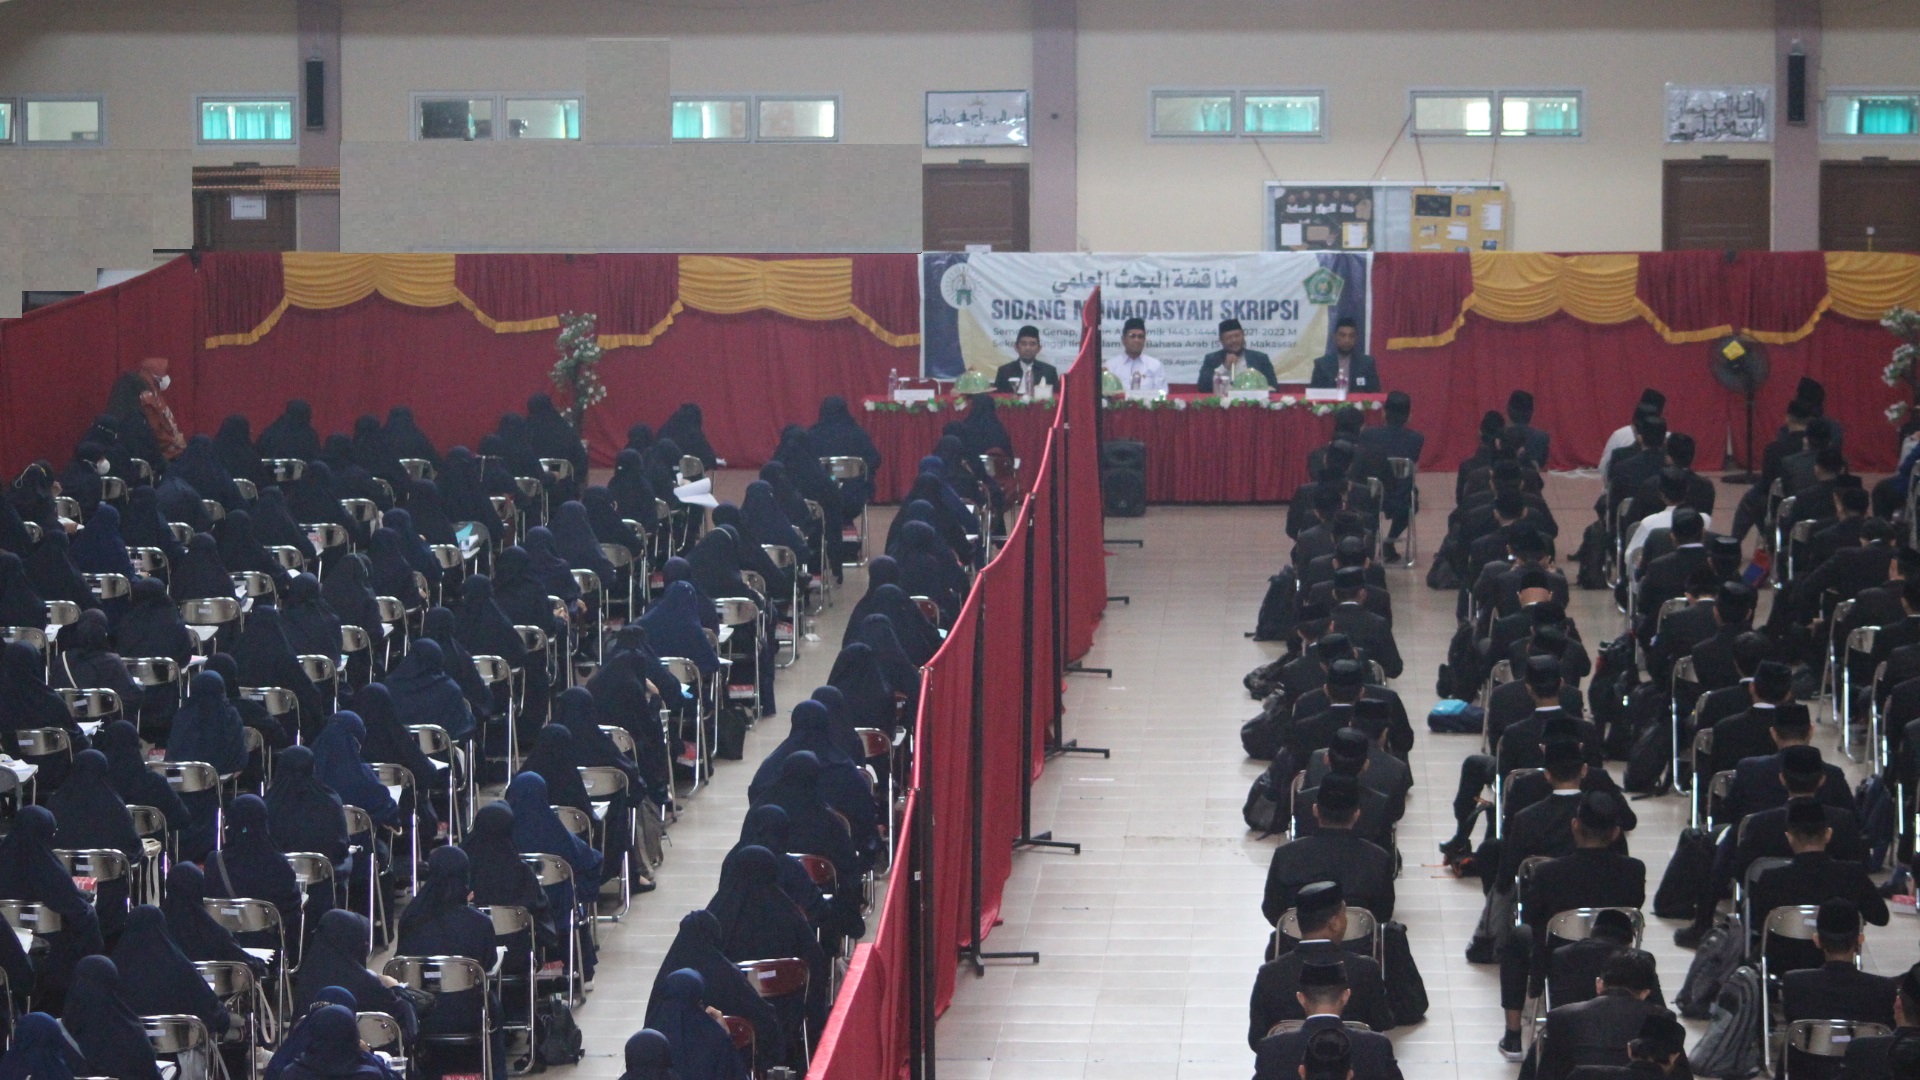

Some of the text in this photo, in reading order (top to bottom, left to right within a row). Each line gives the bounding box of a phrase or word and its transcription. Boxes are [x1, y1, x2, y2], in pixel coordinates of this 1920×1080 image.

[1114, 269, 1169, 295] البحث
[1172, 266, 1238, 288] مناقشة
[991, 299, 1066, 320] SIDANG
[1220, 299, 1299, 321] SKRIPSI
[1145, 339, 1182, 348] Bahasa
[1185, 339, 1209, 348] Arab
[1250, 339, 1297, 348] Makassar
